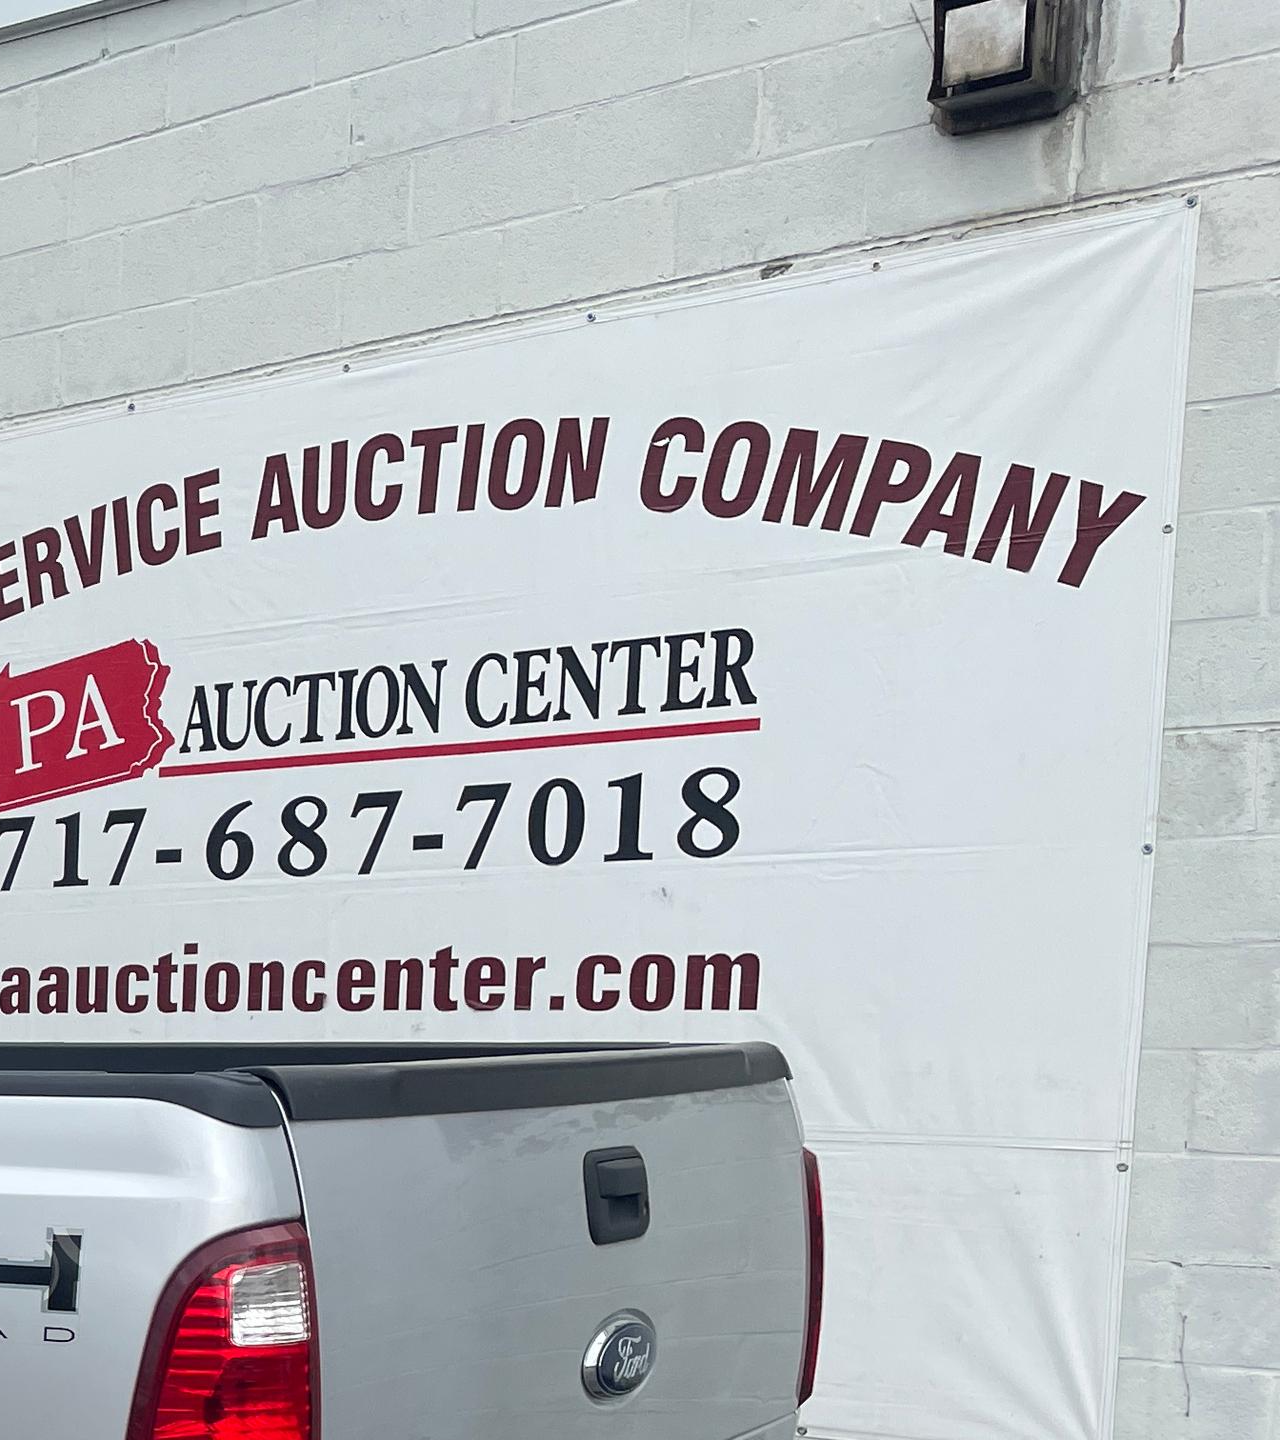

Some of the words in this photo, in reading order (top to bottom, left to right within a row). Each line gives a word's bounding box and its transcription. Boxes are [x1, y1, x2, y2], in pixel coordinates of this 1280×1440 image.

[251, 417, 611, 540] AUCTION
[640, 417, 1147, 588] COMPANY
[10, 673, 126, 775] PA
[179, 660, 447, 754] AUCTION
[465, 627, 757, 729] CENTER
[613, 1335, 650, 1383] Ford
